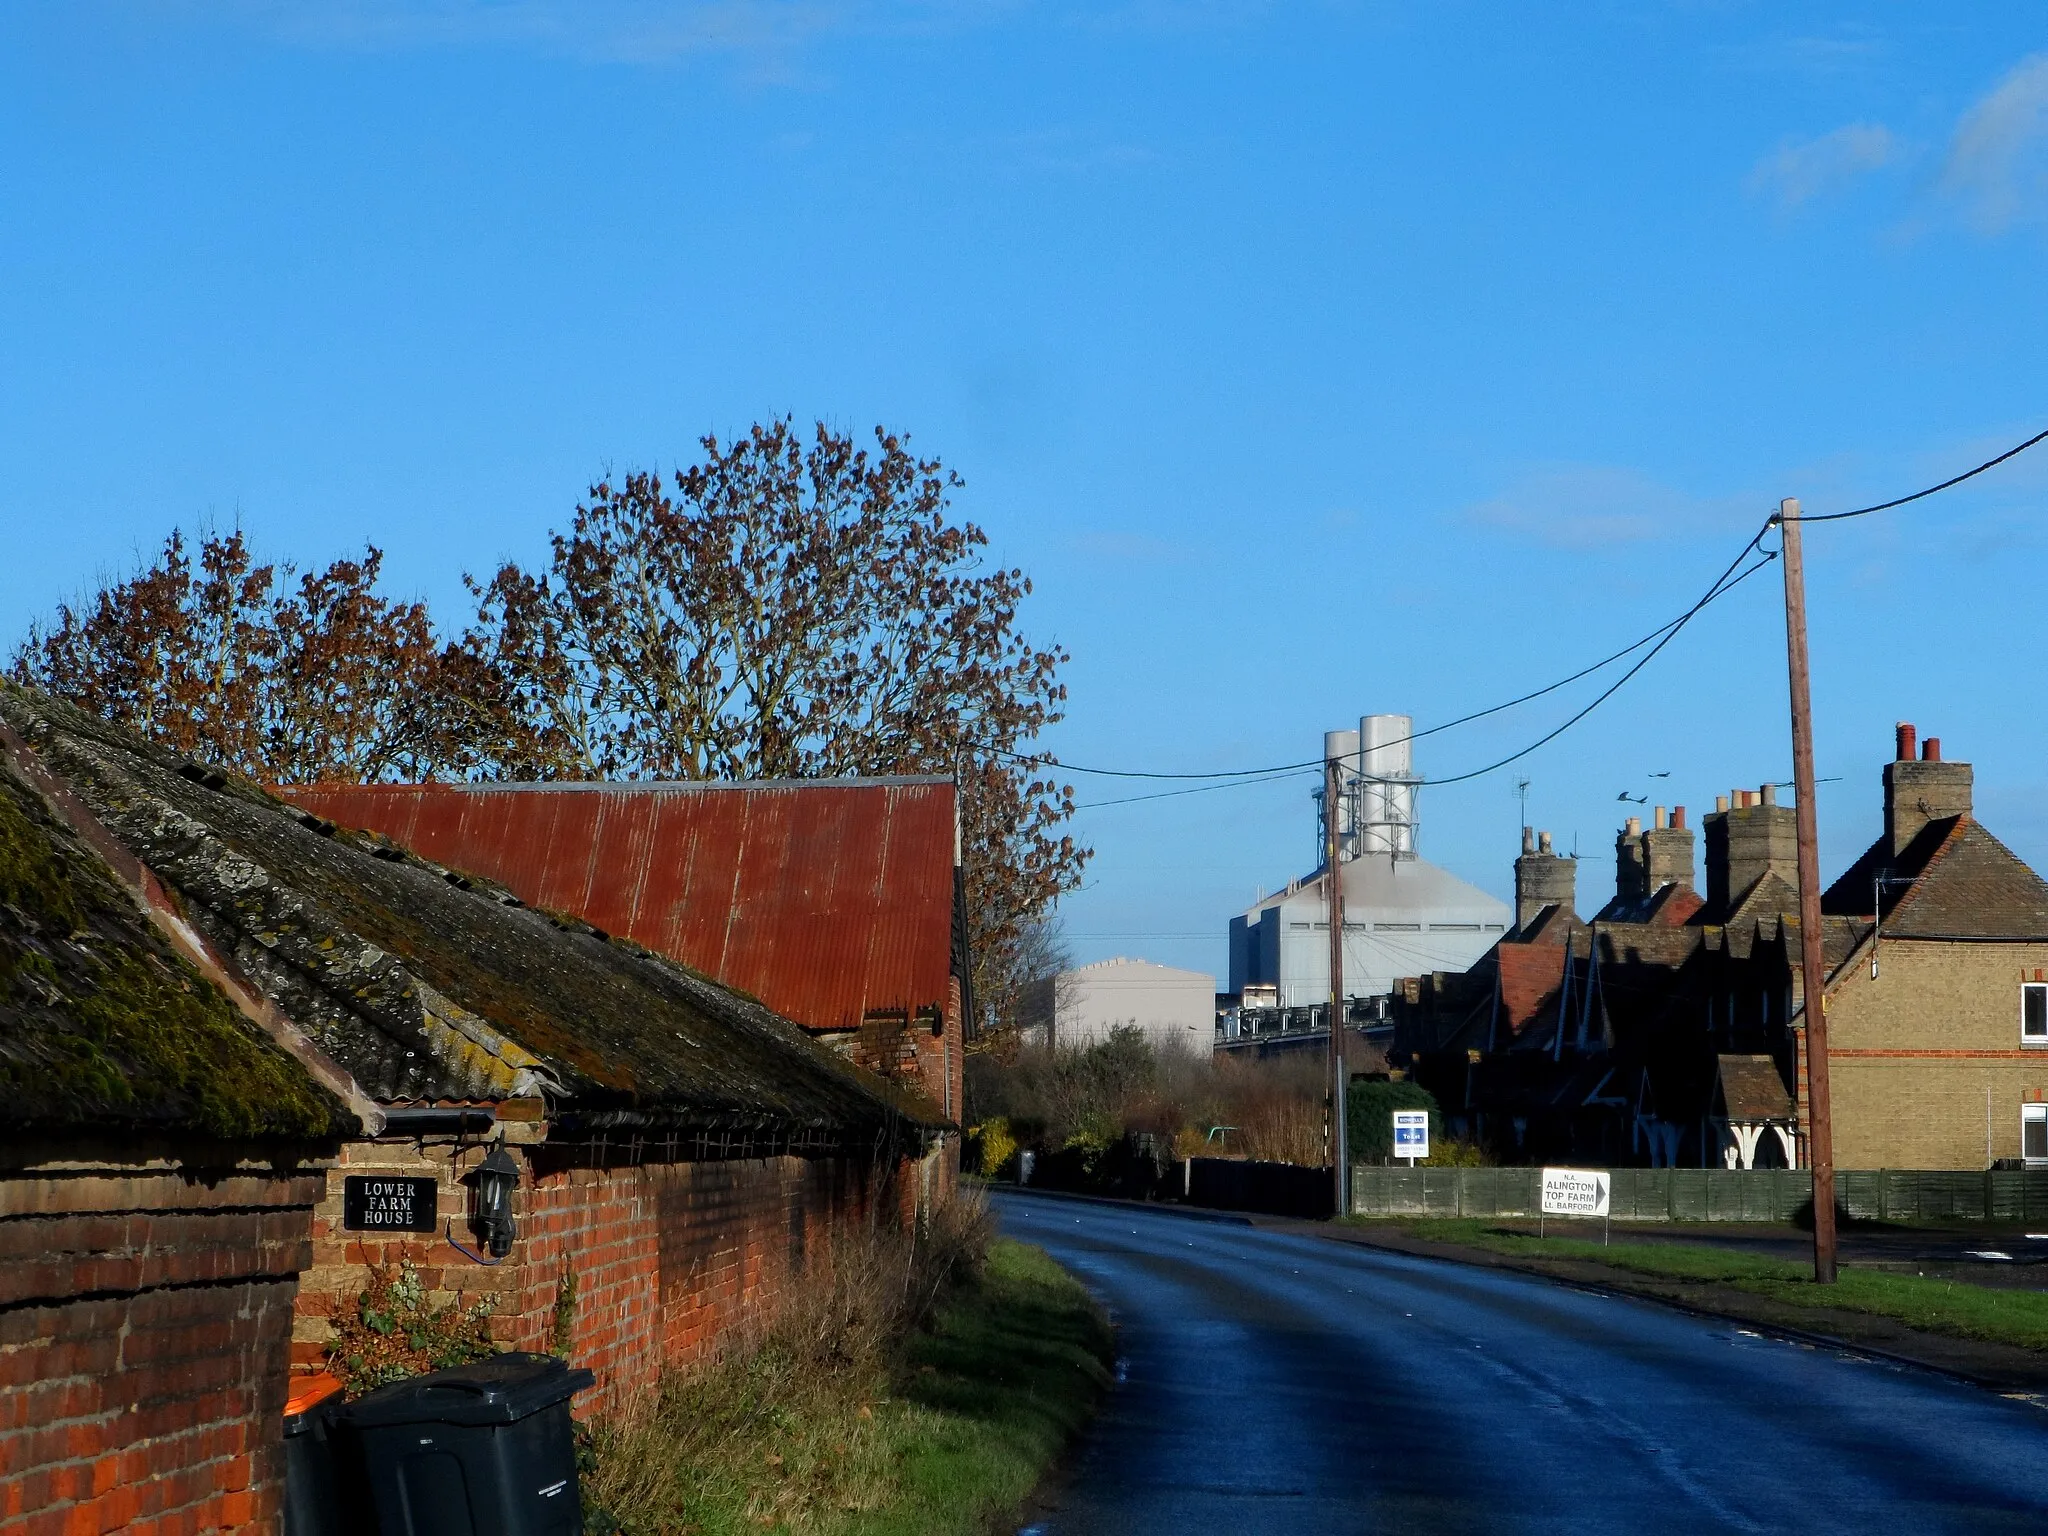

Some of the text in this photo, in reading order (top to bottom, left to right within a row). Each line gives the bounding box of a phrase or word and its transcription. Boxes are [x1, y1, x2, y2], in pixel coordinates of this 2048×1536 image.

[364, 1182, 416, 1197] LOWER
[1546, 1181, 1595, 1192] ALINGTON
[1545, 1191, 1595, 1203] TOP FARM
[369, 1197, 411, 1210] FARM
[1557, 1202, 1594, 1211] BARFORD
[364, 1211, 414, 1225] HOUSE
